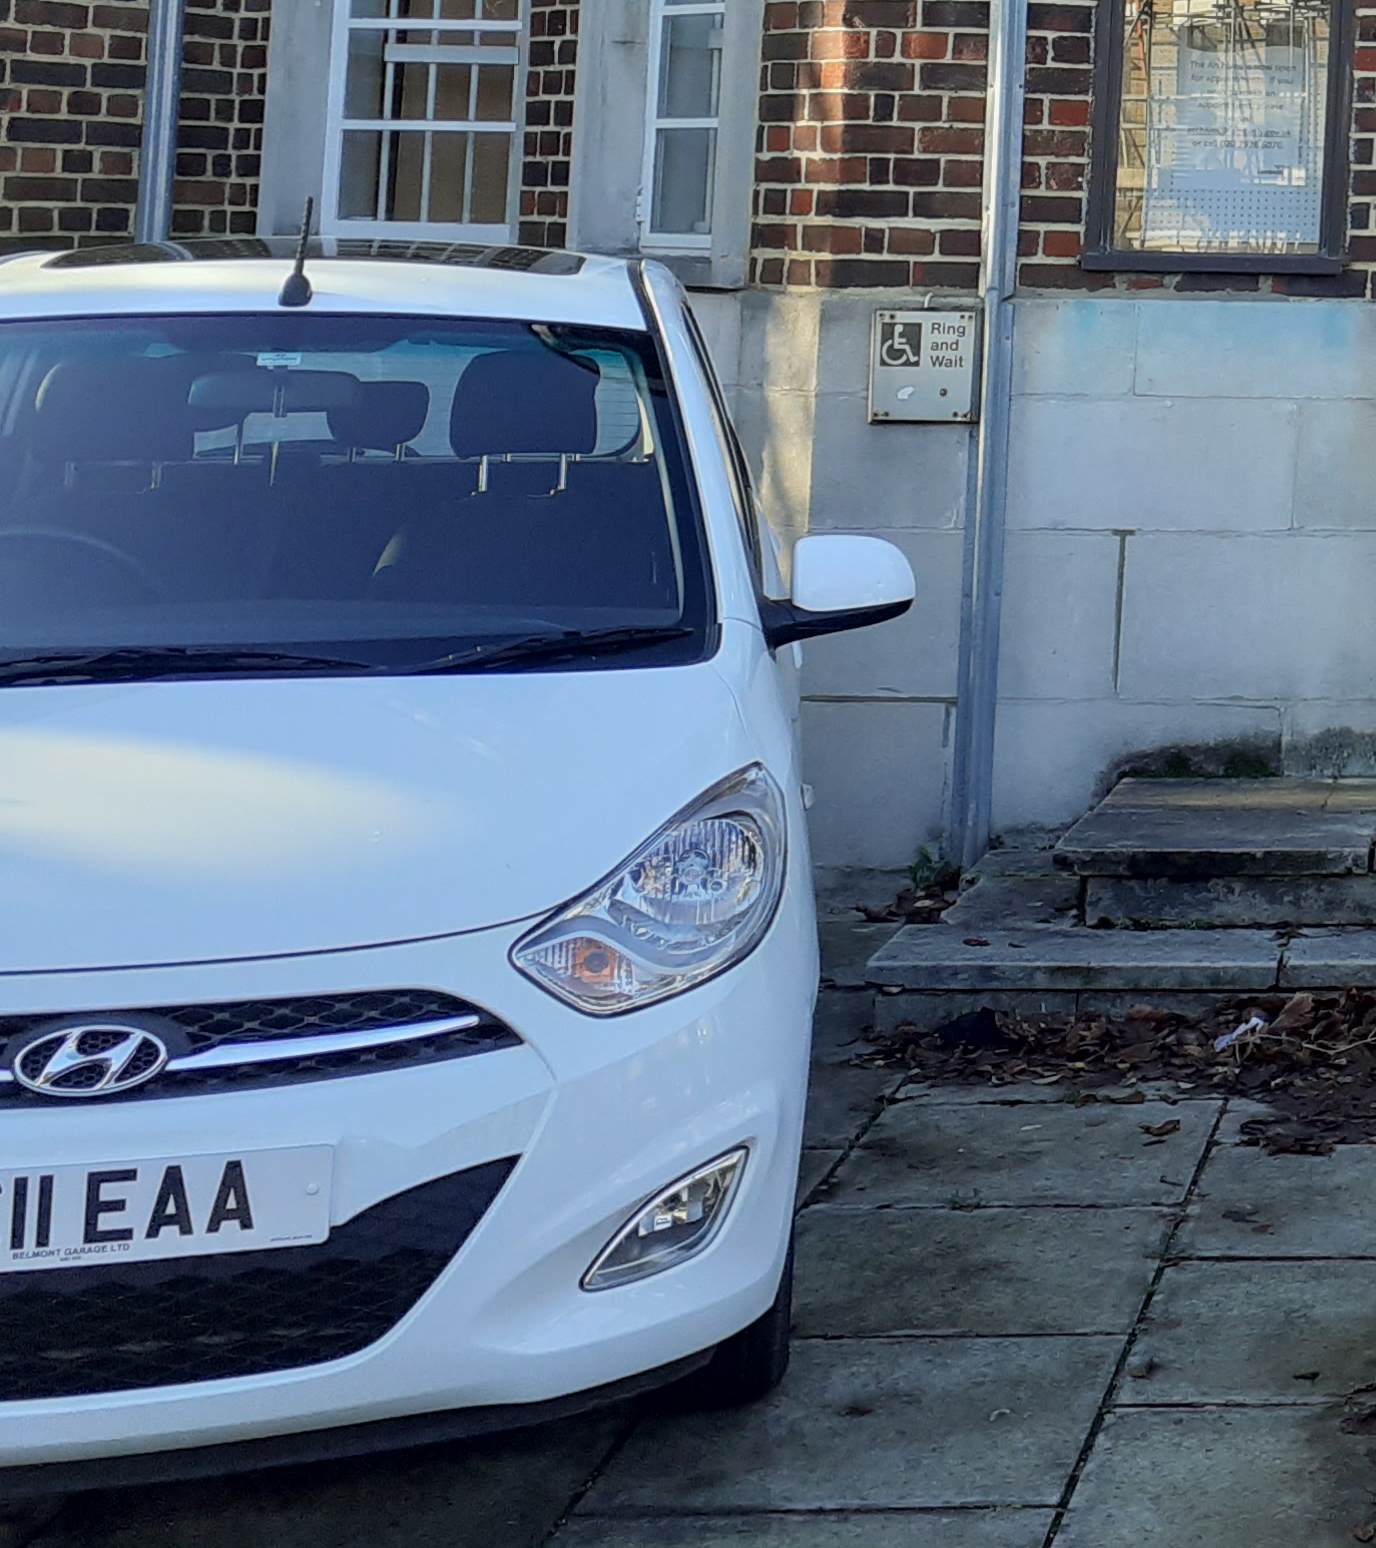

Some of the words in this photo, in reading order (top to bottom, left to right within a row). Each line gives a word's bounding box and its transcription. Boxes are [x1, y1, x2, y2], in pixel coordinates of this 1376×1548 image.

[931, 322, 966, 338] Ring
[930, 338, 959, 351] and
[930, 355, 964, 368] Wait
[0, 1174, 54, 1250] 11
[83, 1159, 255, 1245] EAA
[12, 1250, 60, 1260] BELMONT
[64, 1244, 108, 1256] GARAGE
[110, 1243, 130, 1252] LTD
